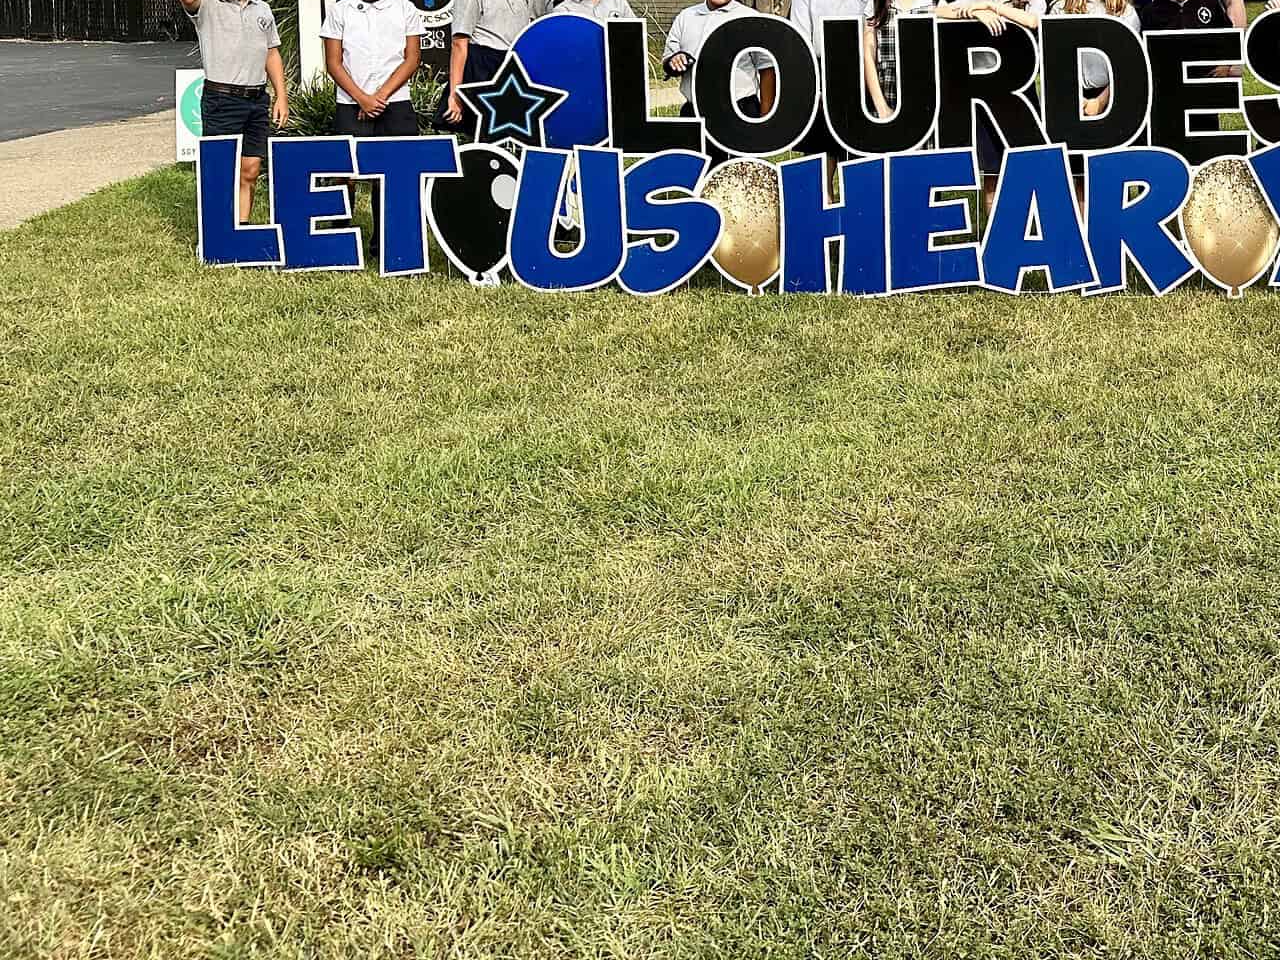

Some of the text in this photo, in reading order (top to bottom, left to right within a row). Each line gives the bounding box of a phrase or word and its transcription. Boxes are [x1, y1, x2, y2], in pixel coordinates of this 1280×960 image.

[195, 133, 462, 277] LET
[508, 145, 724, 295] US
[776, 142, 1201, 297] HEAR
